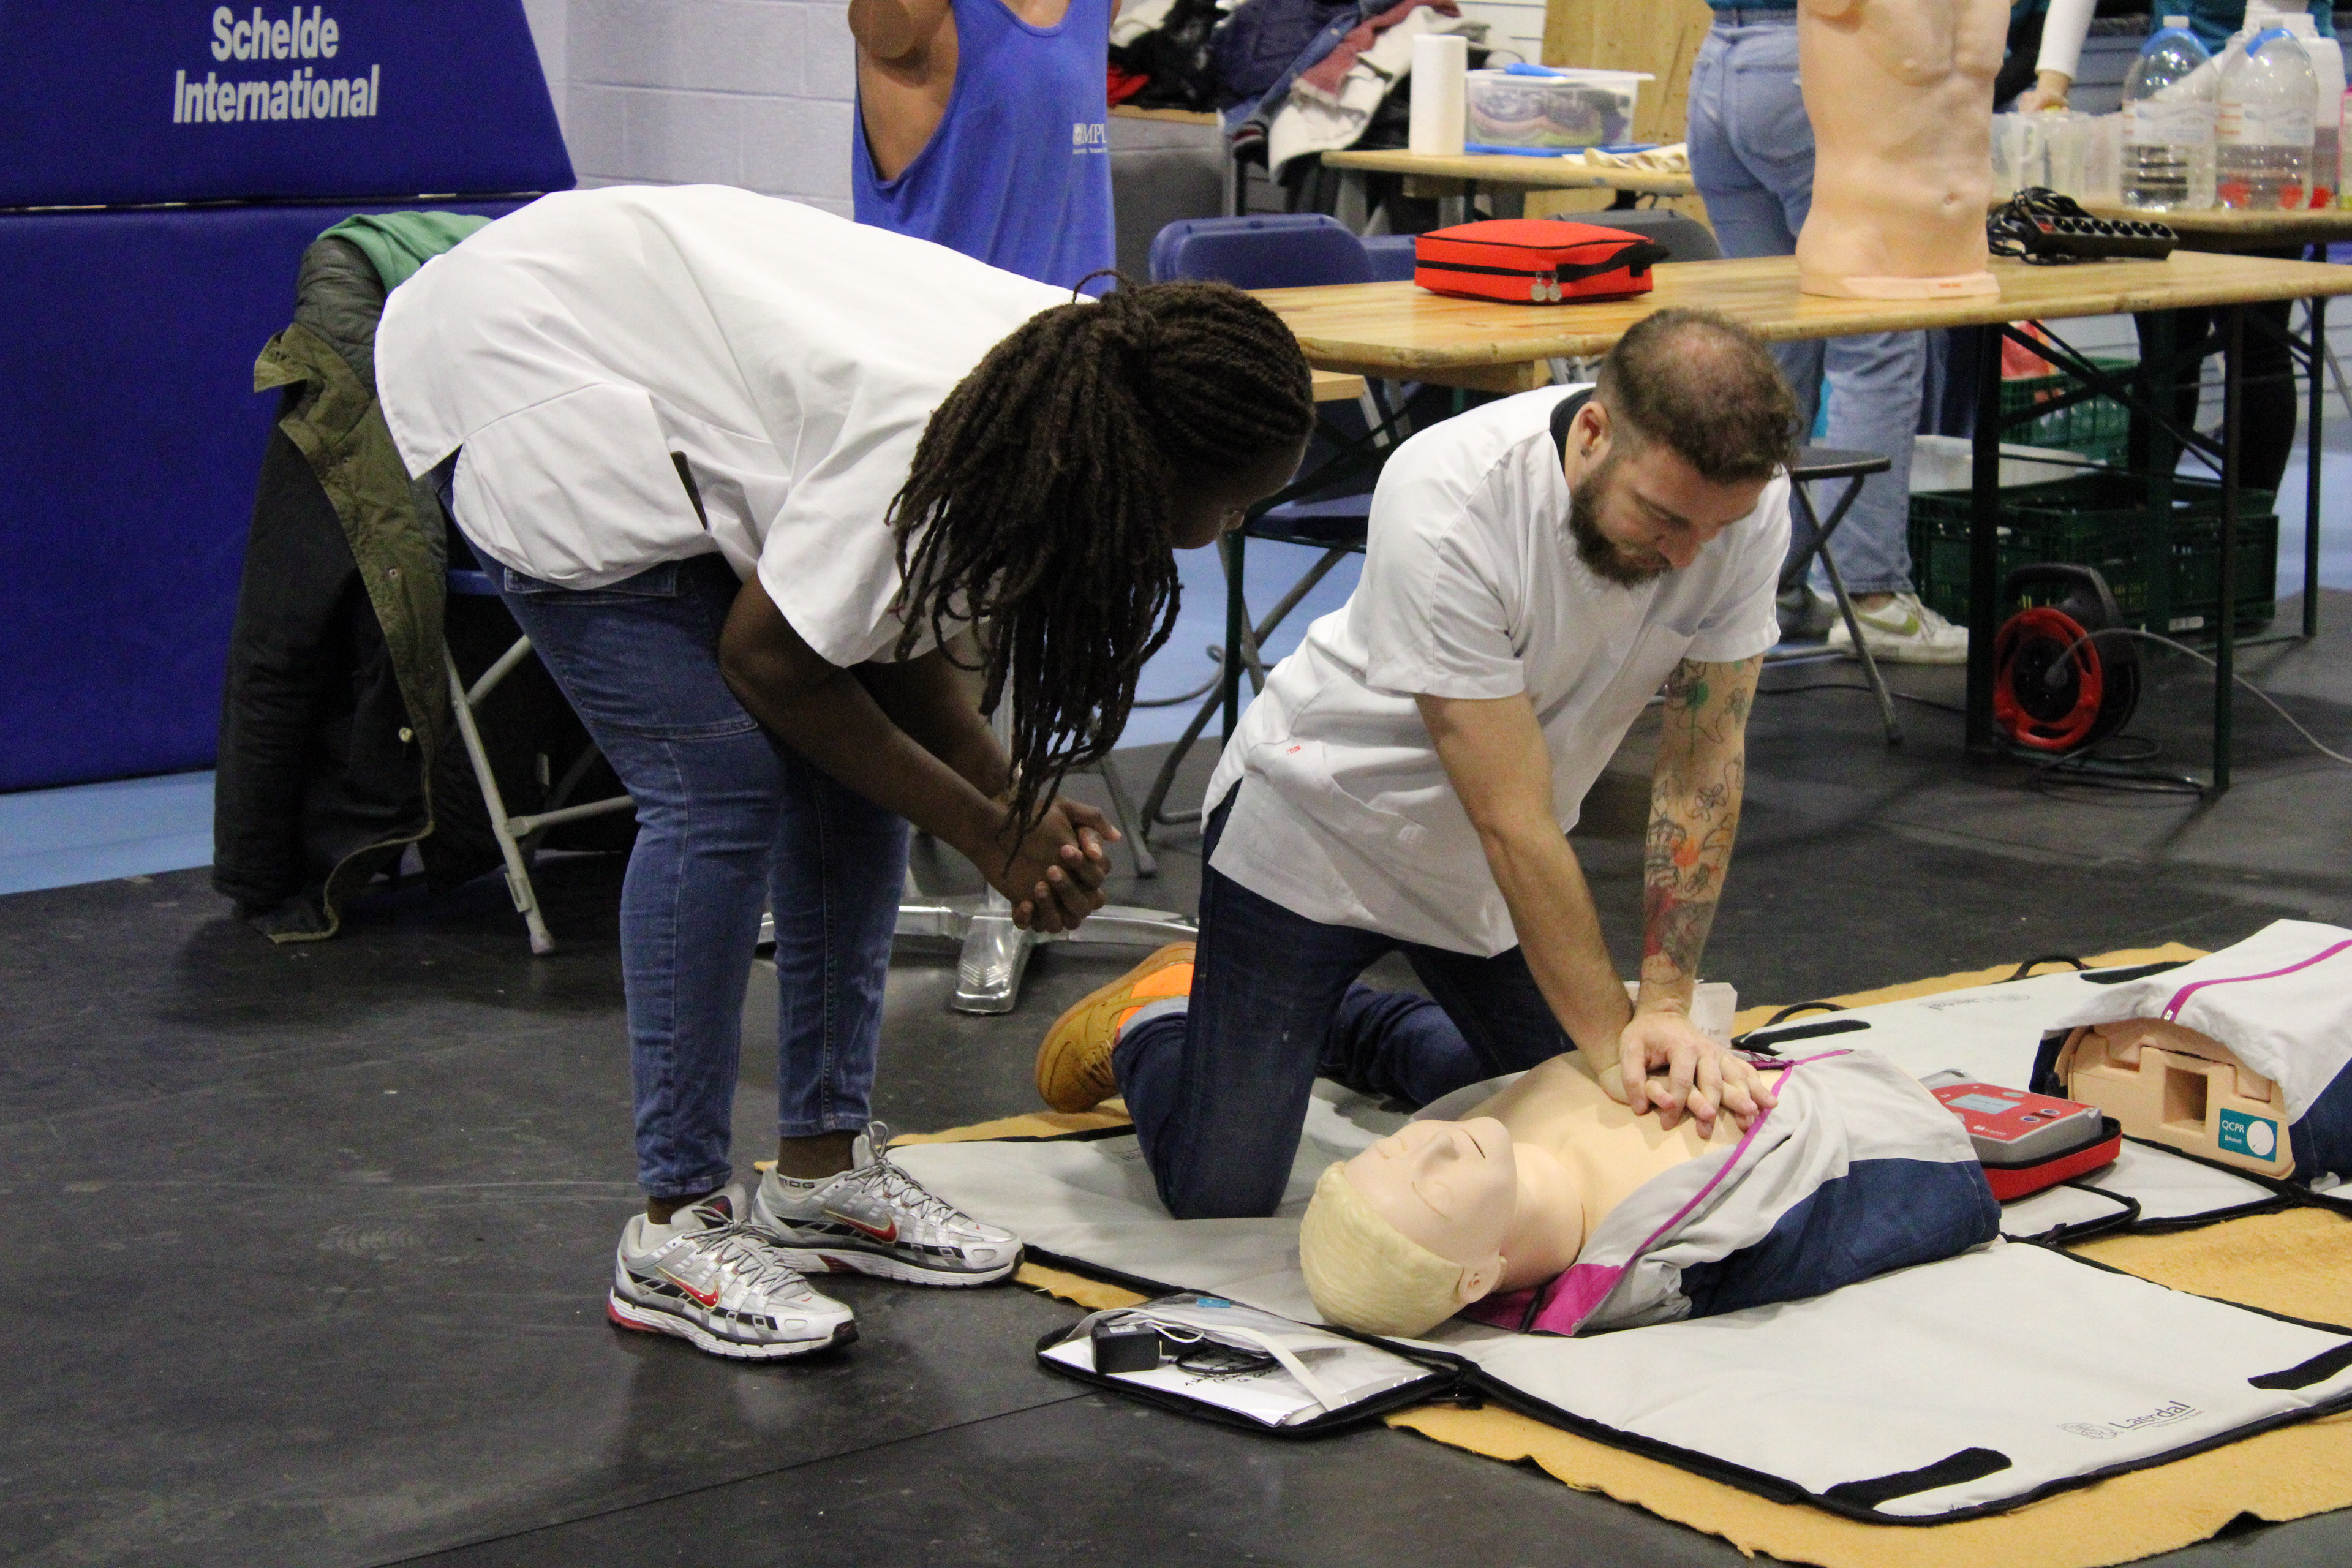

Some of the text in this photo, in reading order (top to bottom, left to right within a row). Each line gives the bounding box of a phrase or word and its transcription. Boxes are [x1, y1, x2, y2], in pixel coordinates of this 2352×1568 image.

[211, 6, 339, 61] Schelde
[173, 64, 380, 123] International
[2222, 1120, 2245, 1134] QCPR
[2108, 1400, 2191, 1429] Laerdal
